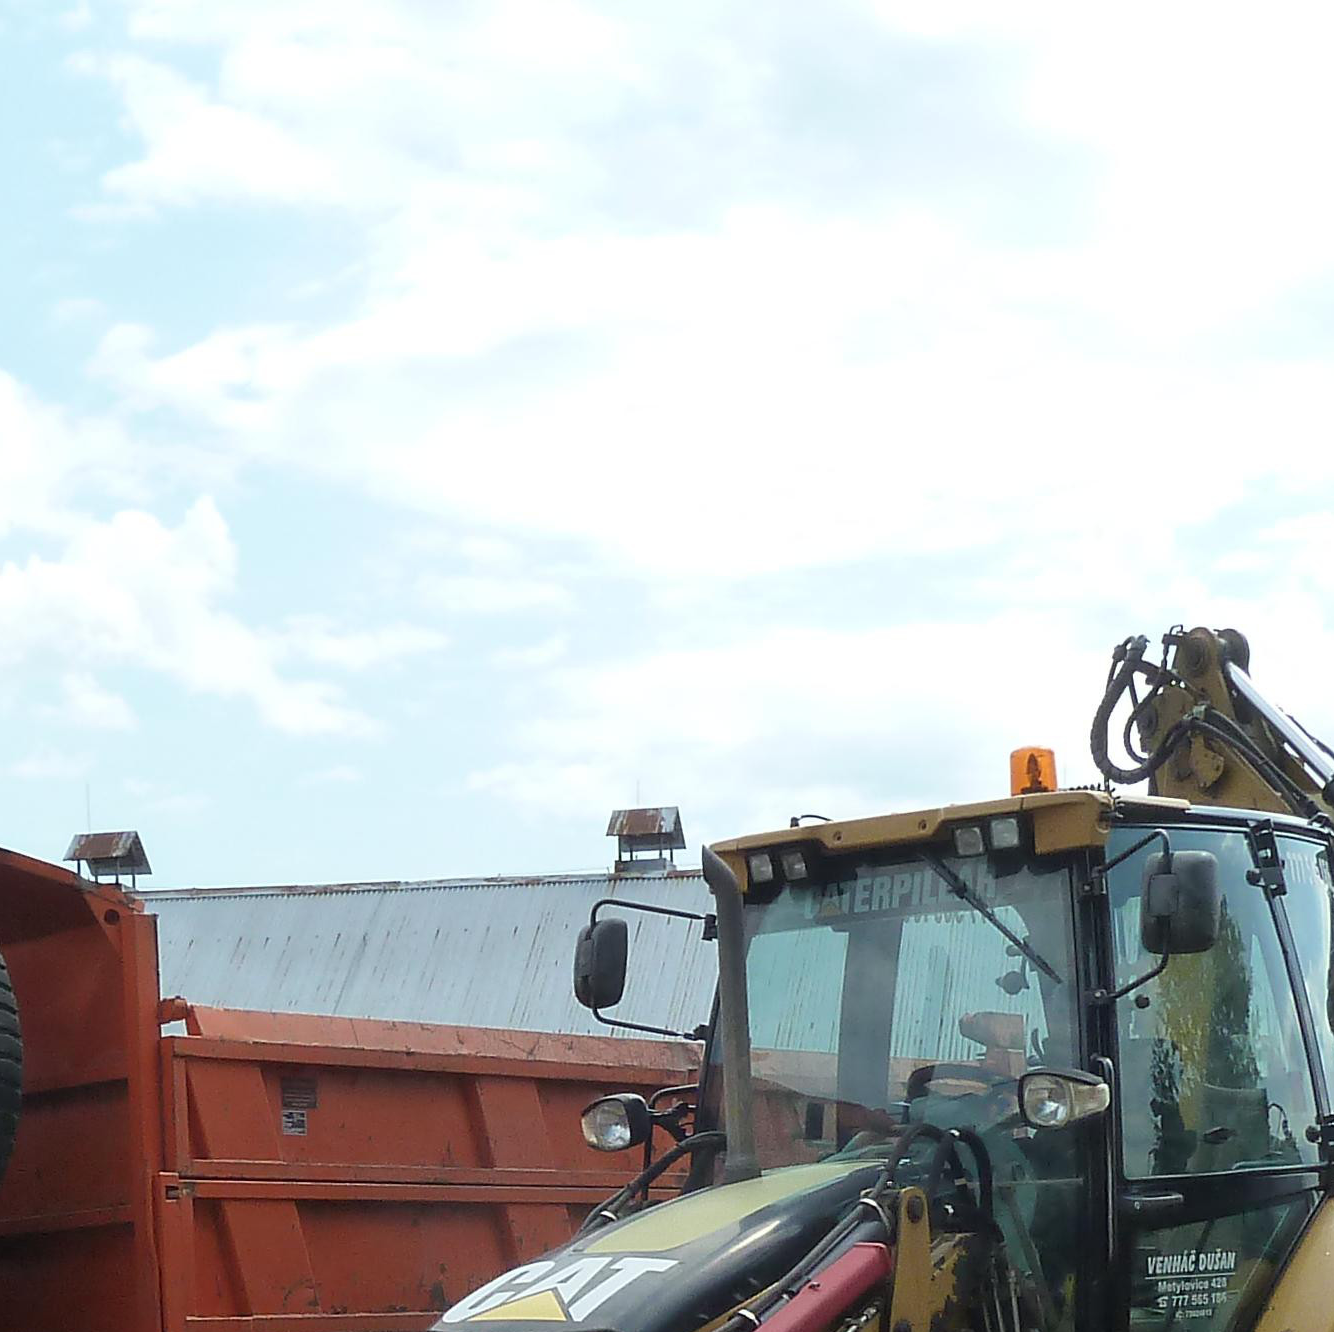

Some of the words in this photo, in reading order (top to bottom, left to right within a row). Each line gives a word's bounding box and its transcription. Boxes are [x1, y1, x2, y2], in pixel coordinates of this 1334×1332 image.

[1147, 1249, 1196, 1275] VENHÁČ
[1198, 1248, 1236, 1271] DUŠAN
[442, 1256, 679, 1323] CAT
[1172, 1294, 1189, 1307] 777
